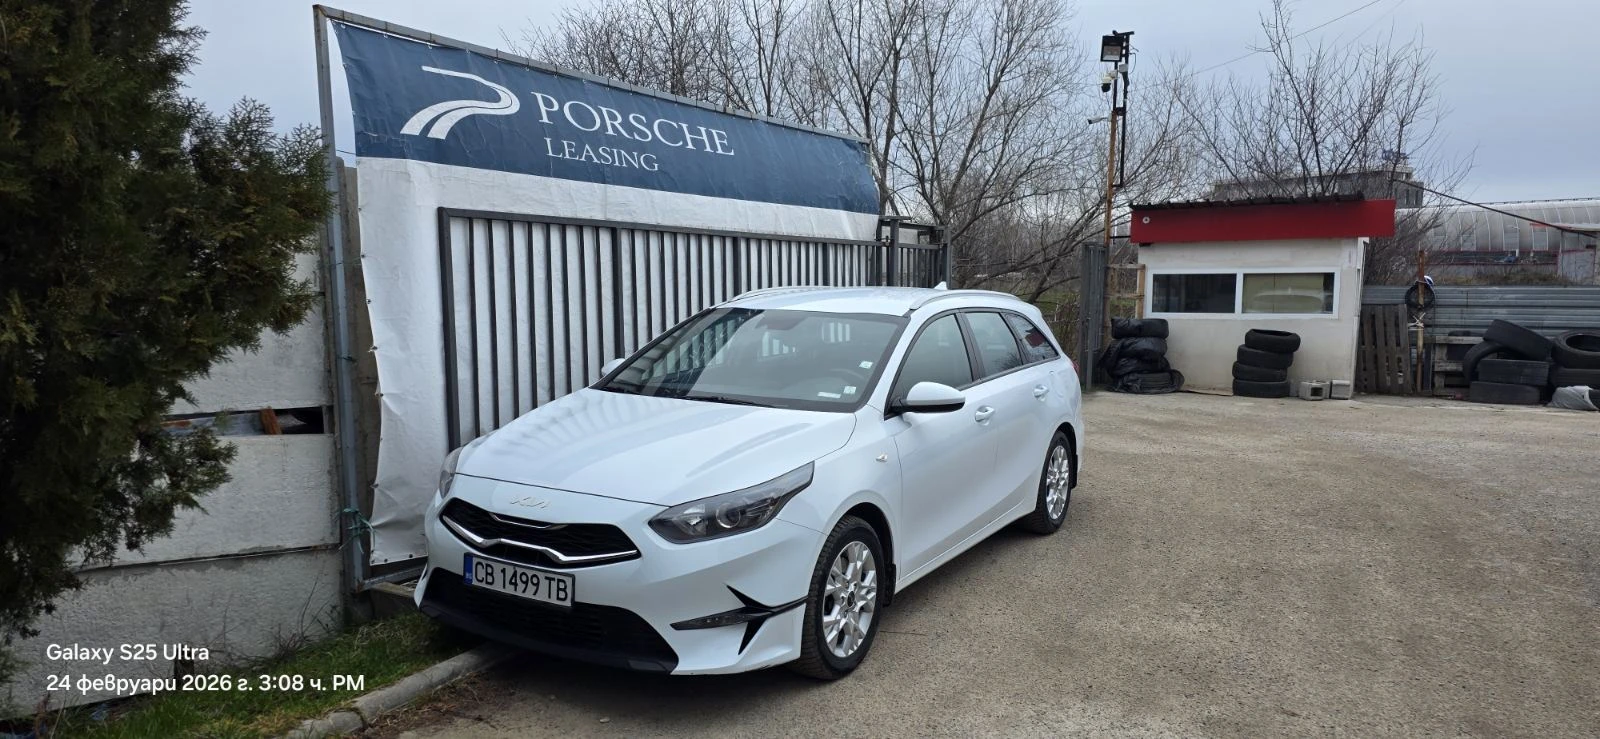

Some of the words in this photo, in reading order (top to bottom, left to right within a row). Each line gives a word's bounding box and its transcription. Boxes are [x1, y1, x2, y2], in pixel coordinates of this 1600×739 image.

[530, 91, 735, 156] PORSCHE
[543, 136, 659, 171] LEASING
[474, 561, 495, 586] CB
[500, 567, 540, 596] 1499
[544, 576, 568, 602] TB
